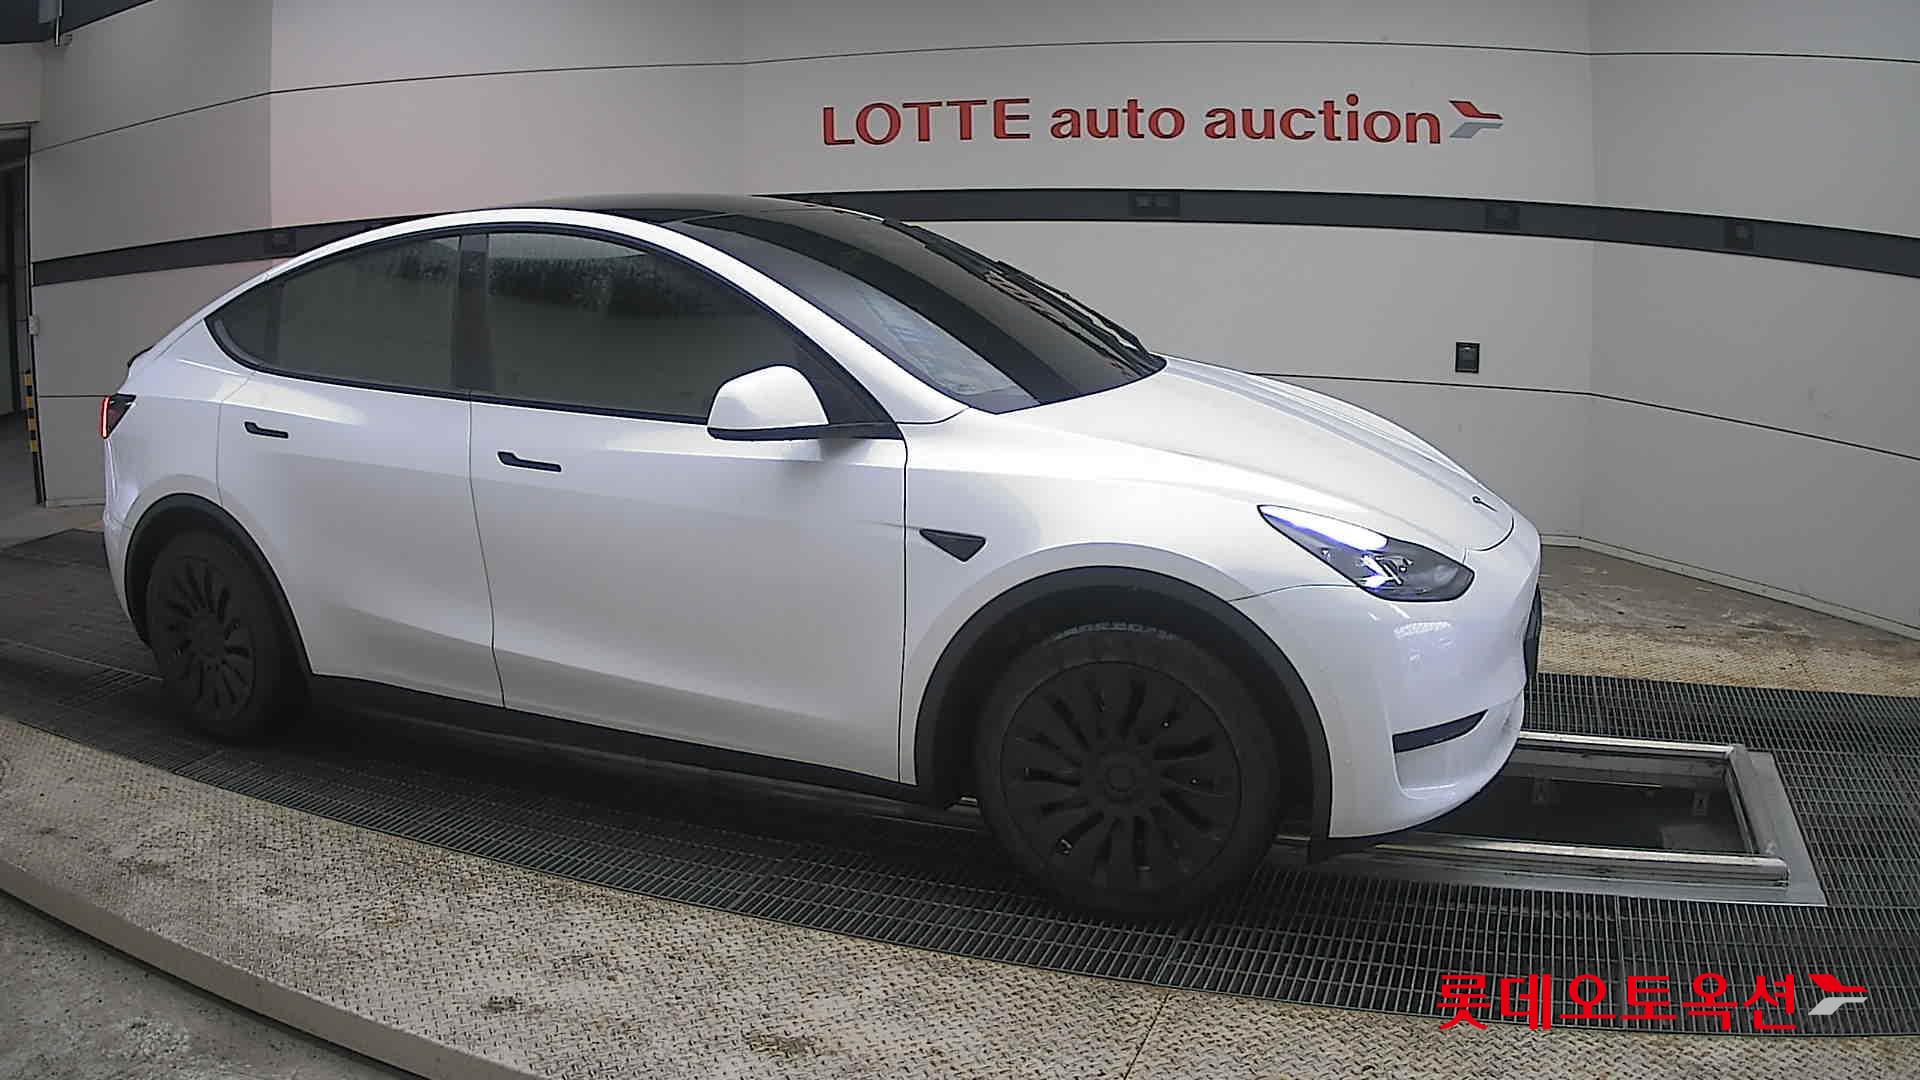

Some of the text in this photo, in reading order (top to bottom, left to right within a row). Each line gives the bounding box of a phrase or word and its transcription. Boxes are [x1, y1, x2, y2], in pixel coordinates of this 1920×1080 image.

[822, 94, 1441, 146] LOTTE auto auction
